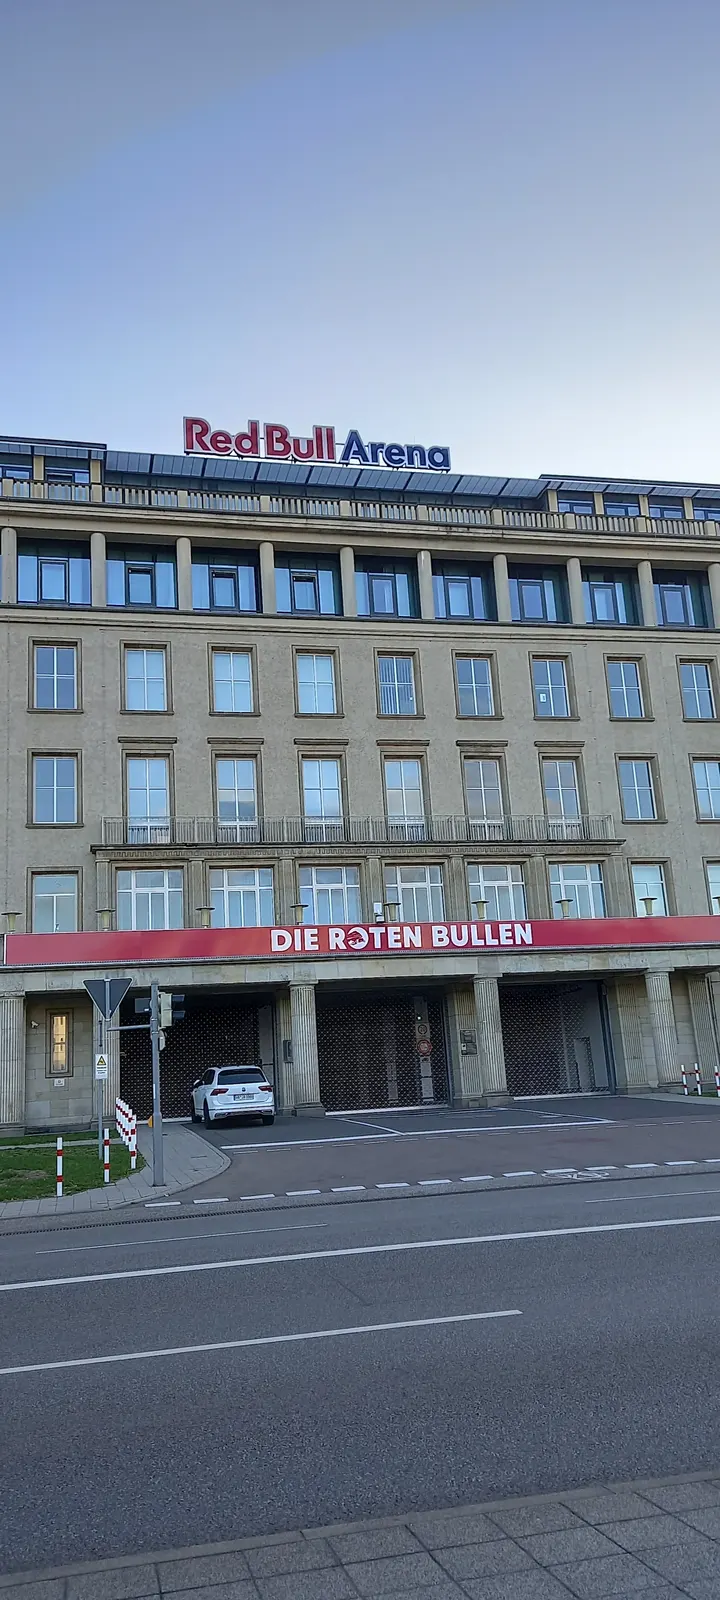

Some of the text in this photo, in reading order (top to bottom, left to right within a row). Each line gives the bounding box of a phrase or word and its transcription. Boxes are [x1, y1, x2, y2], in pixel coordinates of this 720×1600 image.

[183, 416, 451, 470] Red Bull Arena
[270, 923, 533, 951] DIE ROTEN BULLEN
